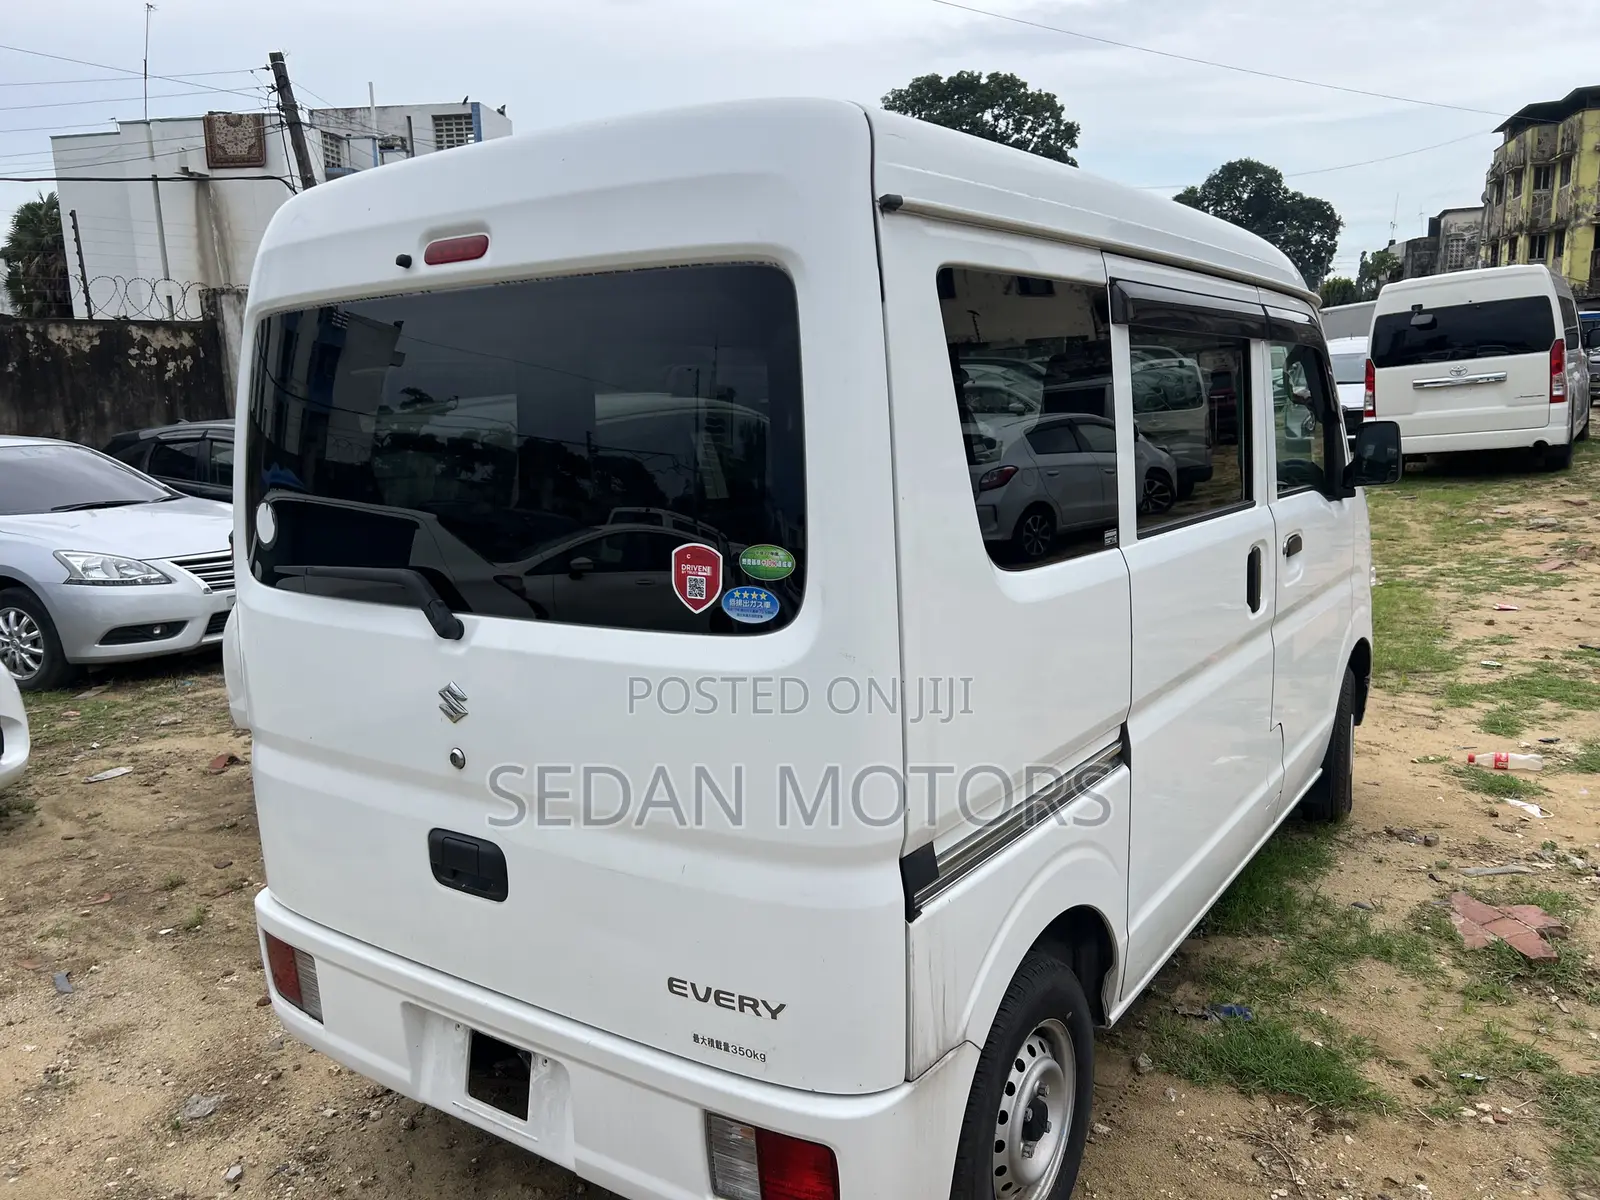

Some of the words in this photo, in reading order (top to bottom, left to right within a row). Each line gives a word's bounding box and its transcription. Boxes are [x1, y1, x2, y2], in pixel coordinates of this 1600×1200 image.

[667, 976, 786, 1021] EVERY
[692, 1033, 766, 1063] 最大積載量350kg
